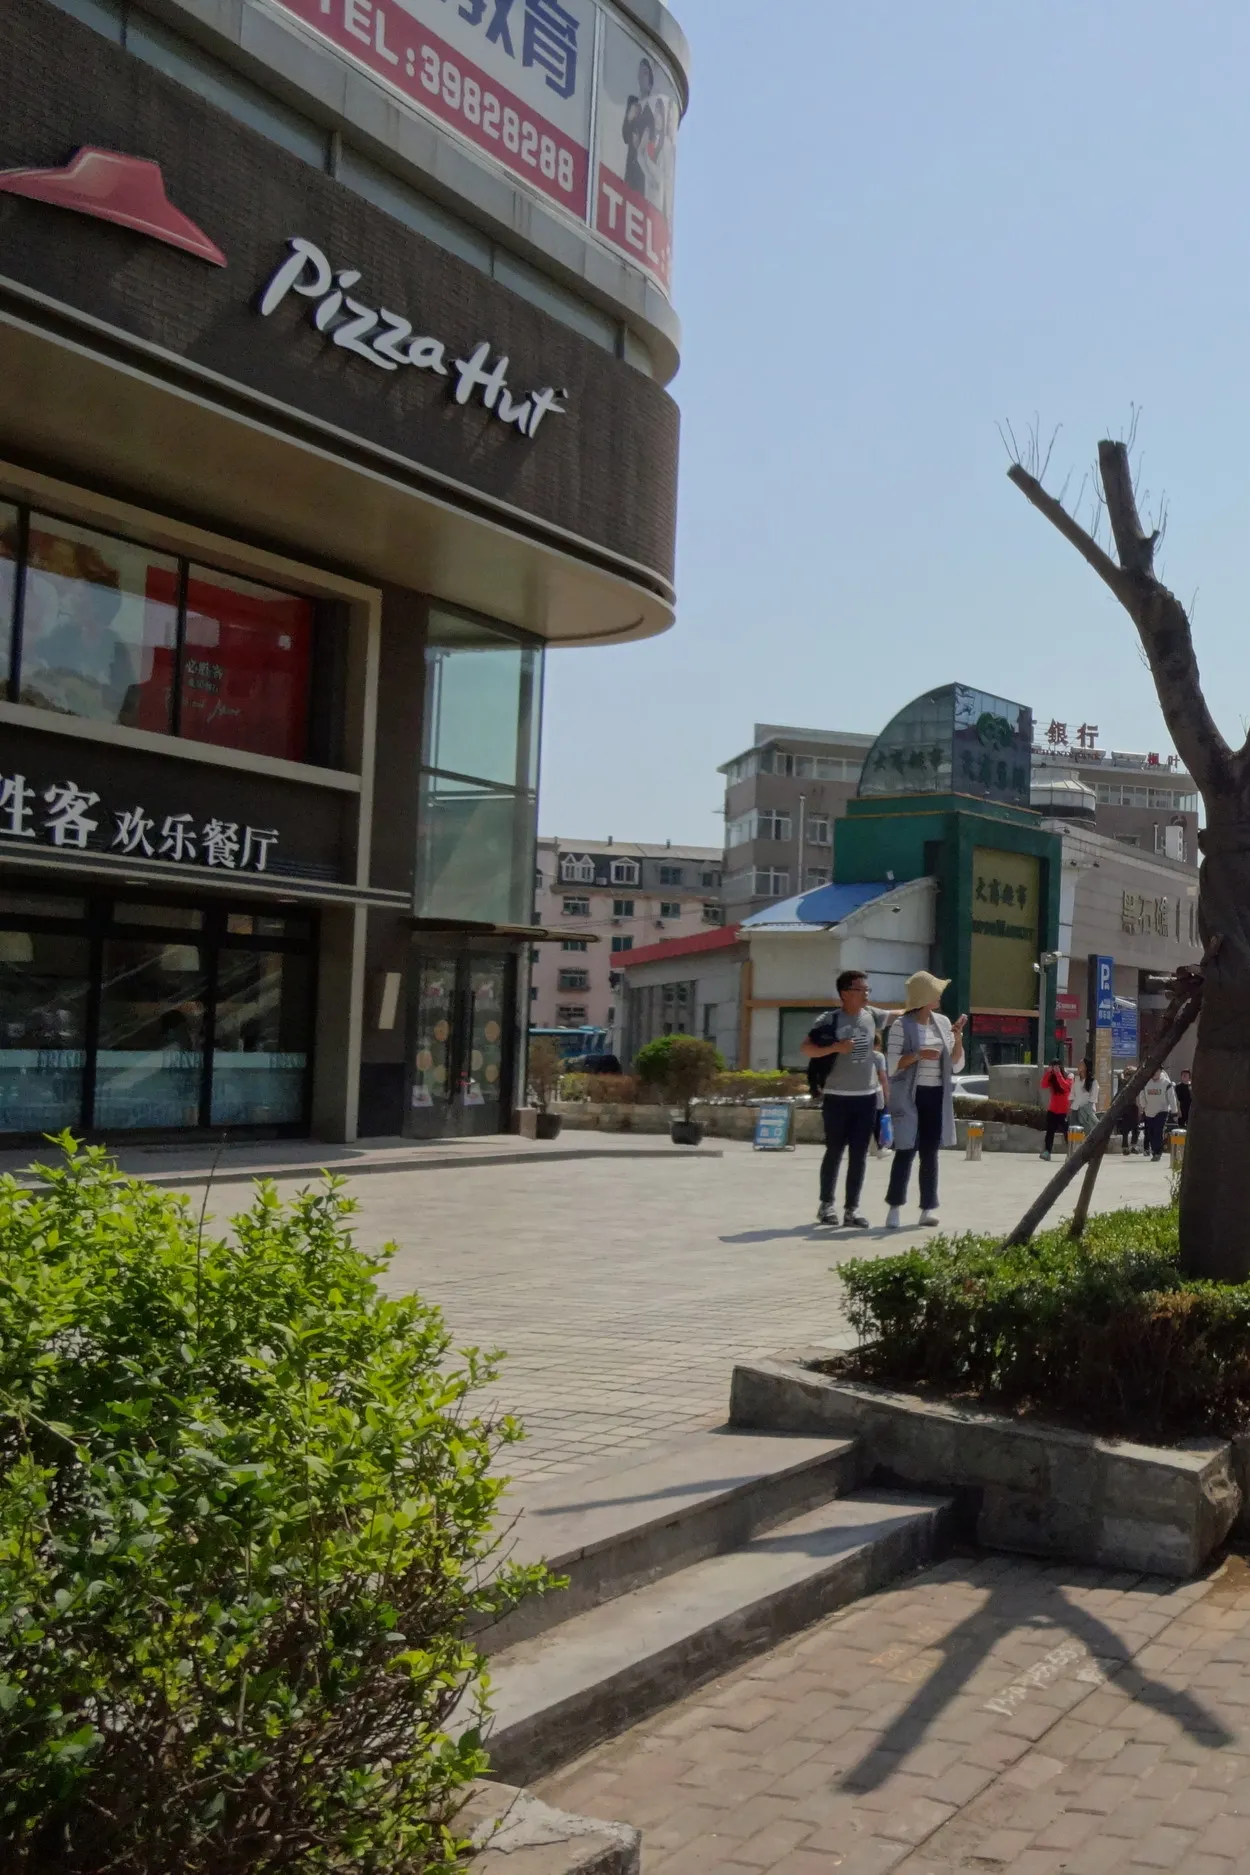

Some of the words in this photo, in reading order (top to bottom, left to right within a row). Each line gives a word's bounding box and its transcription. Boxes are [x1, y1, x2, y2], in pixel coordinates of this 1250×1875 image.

[603, 182, 671, 282] TEL:
[260, 237, 449, 376] Pizza
[454, 341, 567, 439] Hut
[111, 806, 280, 872] 欢乐餐厅
